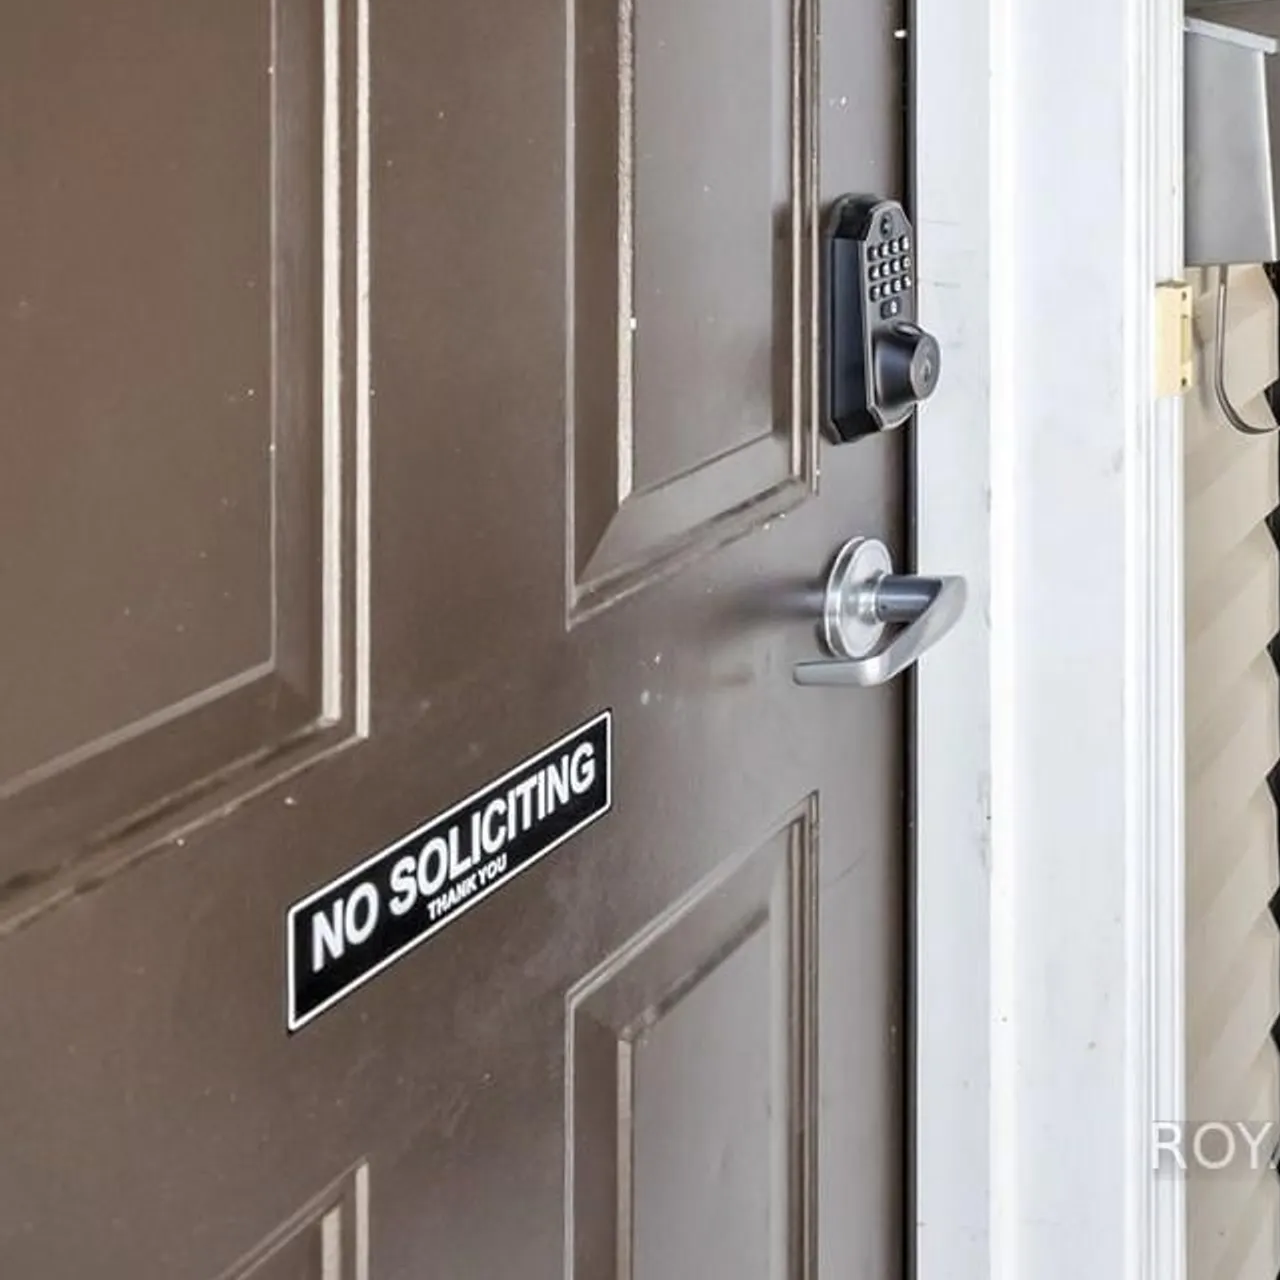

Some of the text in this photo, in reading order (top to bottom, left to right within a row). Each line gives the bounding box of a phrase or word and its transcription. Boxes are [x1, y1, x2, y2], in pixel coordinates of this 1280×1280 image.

[311, 741, 596, 972] NO SOLICITING
[427, 853, 508, 921] THANK YOU
